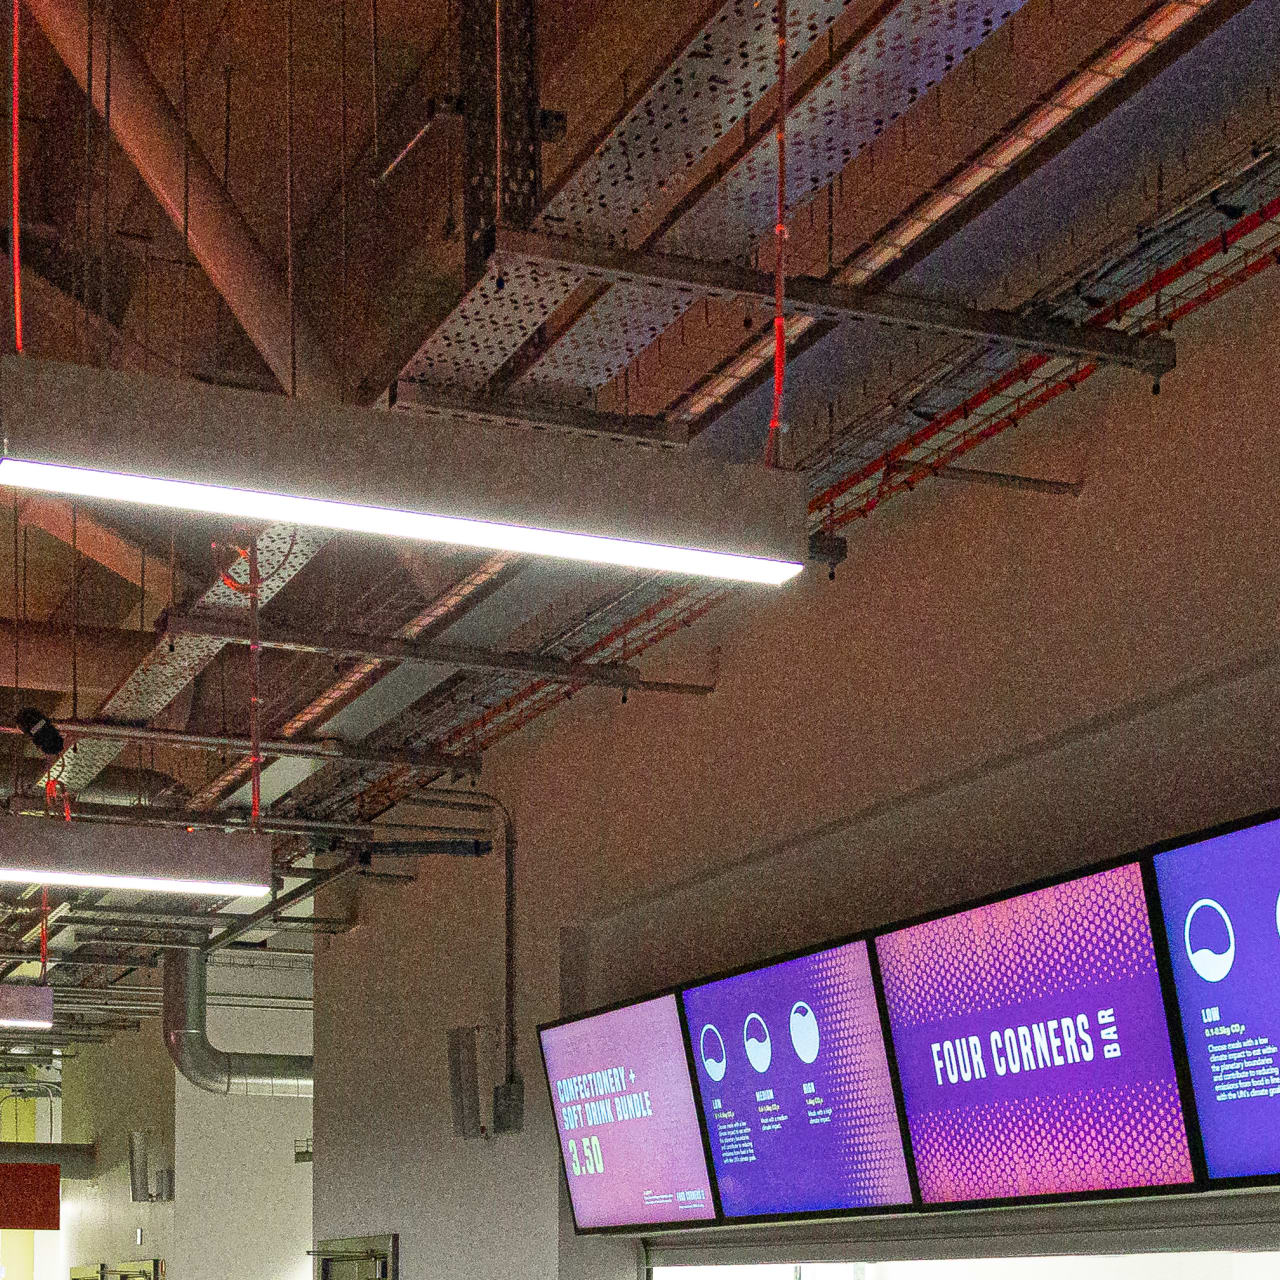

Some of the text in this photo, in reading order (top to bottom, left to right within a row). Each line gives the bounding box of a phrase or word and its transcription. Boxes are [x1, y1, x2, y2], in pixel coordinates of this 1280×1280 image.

[1097, 1007, 1121, 1059] BAR
[1201, 1007, 1220, 1023] LOW
[930, 1013, 1094, 1086] FOUR CORNERS
[556, 1066, 635, 1104] CONFECTIONERY +
[561, 1090, 653, 1131] SOFT DRINK BUNDLE
[568, 1135, 605, 1177] 3.50
